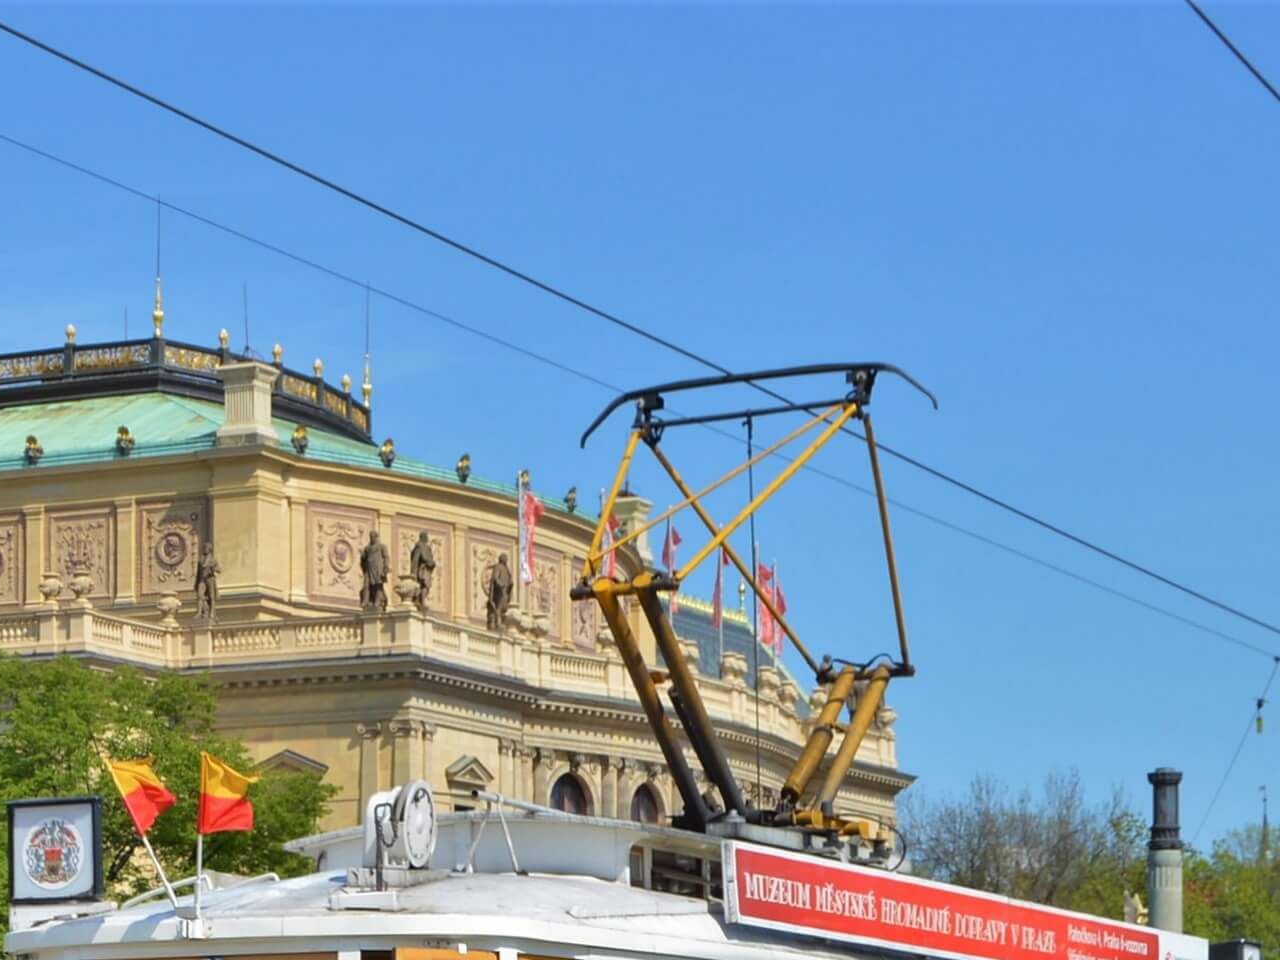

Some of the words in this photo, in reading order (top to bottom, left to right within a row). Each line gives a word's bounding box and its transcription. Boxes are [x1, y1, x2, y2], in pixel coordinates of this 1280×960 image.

[744, 871, 812, 910] MUZEUM
[815, 882, 877, 921] MĚSTSKÉ
[880, 896, 951, 935] HROMADNÉ
[954, 912, 1008, 945] DOPRAVY
[1010, 923, 1020, 947] V
[1021, 925, 1057, 954] PRAZE
